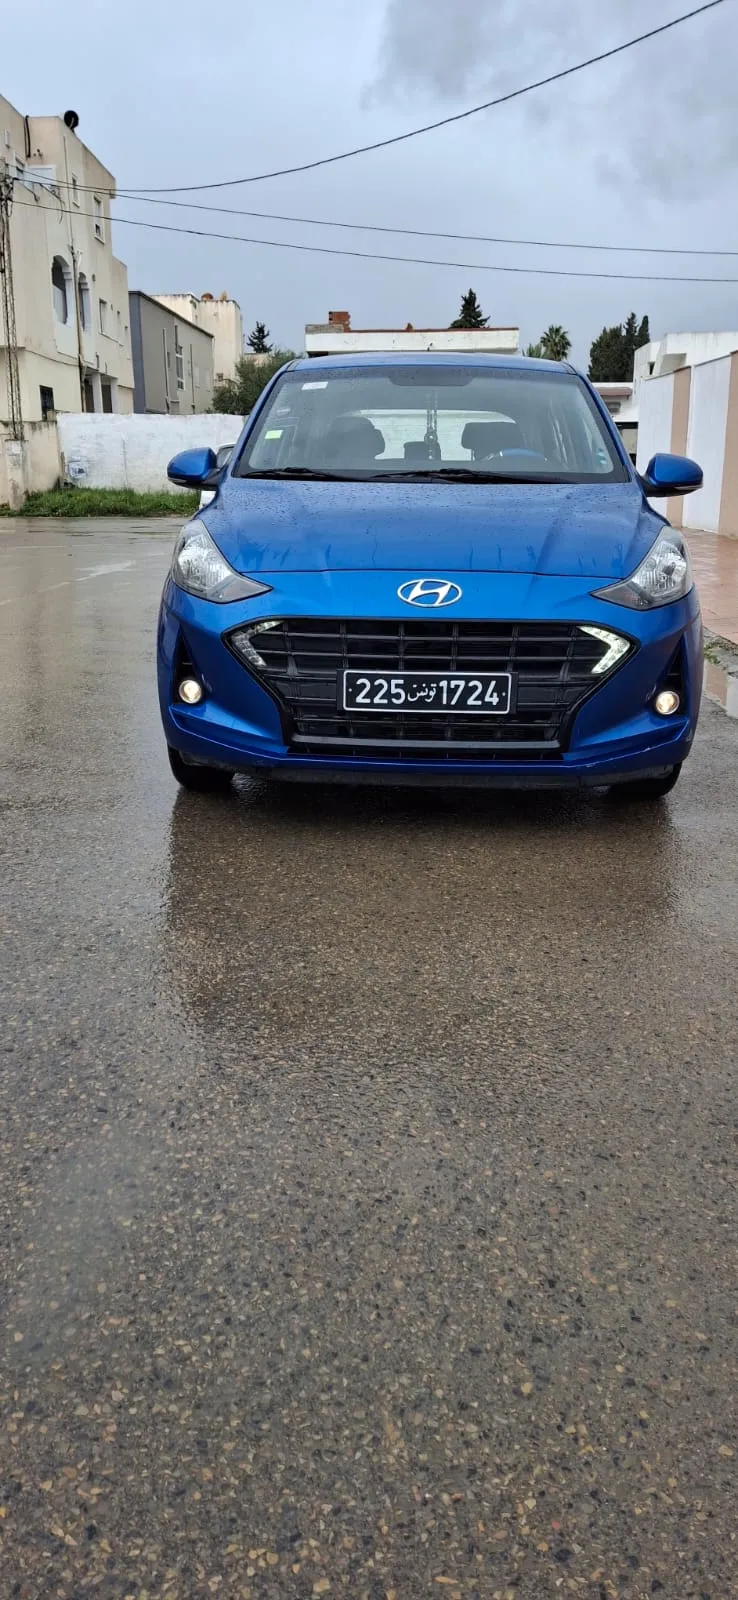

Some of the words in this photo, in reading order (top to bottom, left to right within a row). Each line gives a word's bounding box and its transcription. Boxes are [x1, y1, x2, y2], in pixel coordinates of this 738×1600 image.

[355, 678, 406, 704] 225
[407, 683, 437, 702] تونس
[439, 680, 499, 706] 1724
